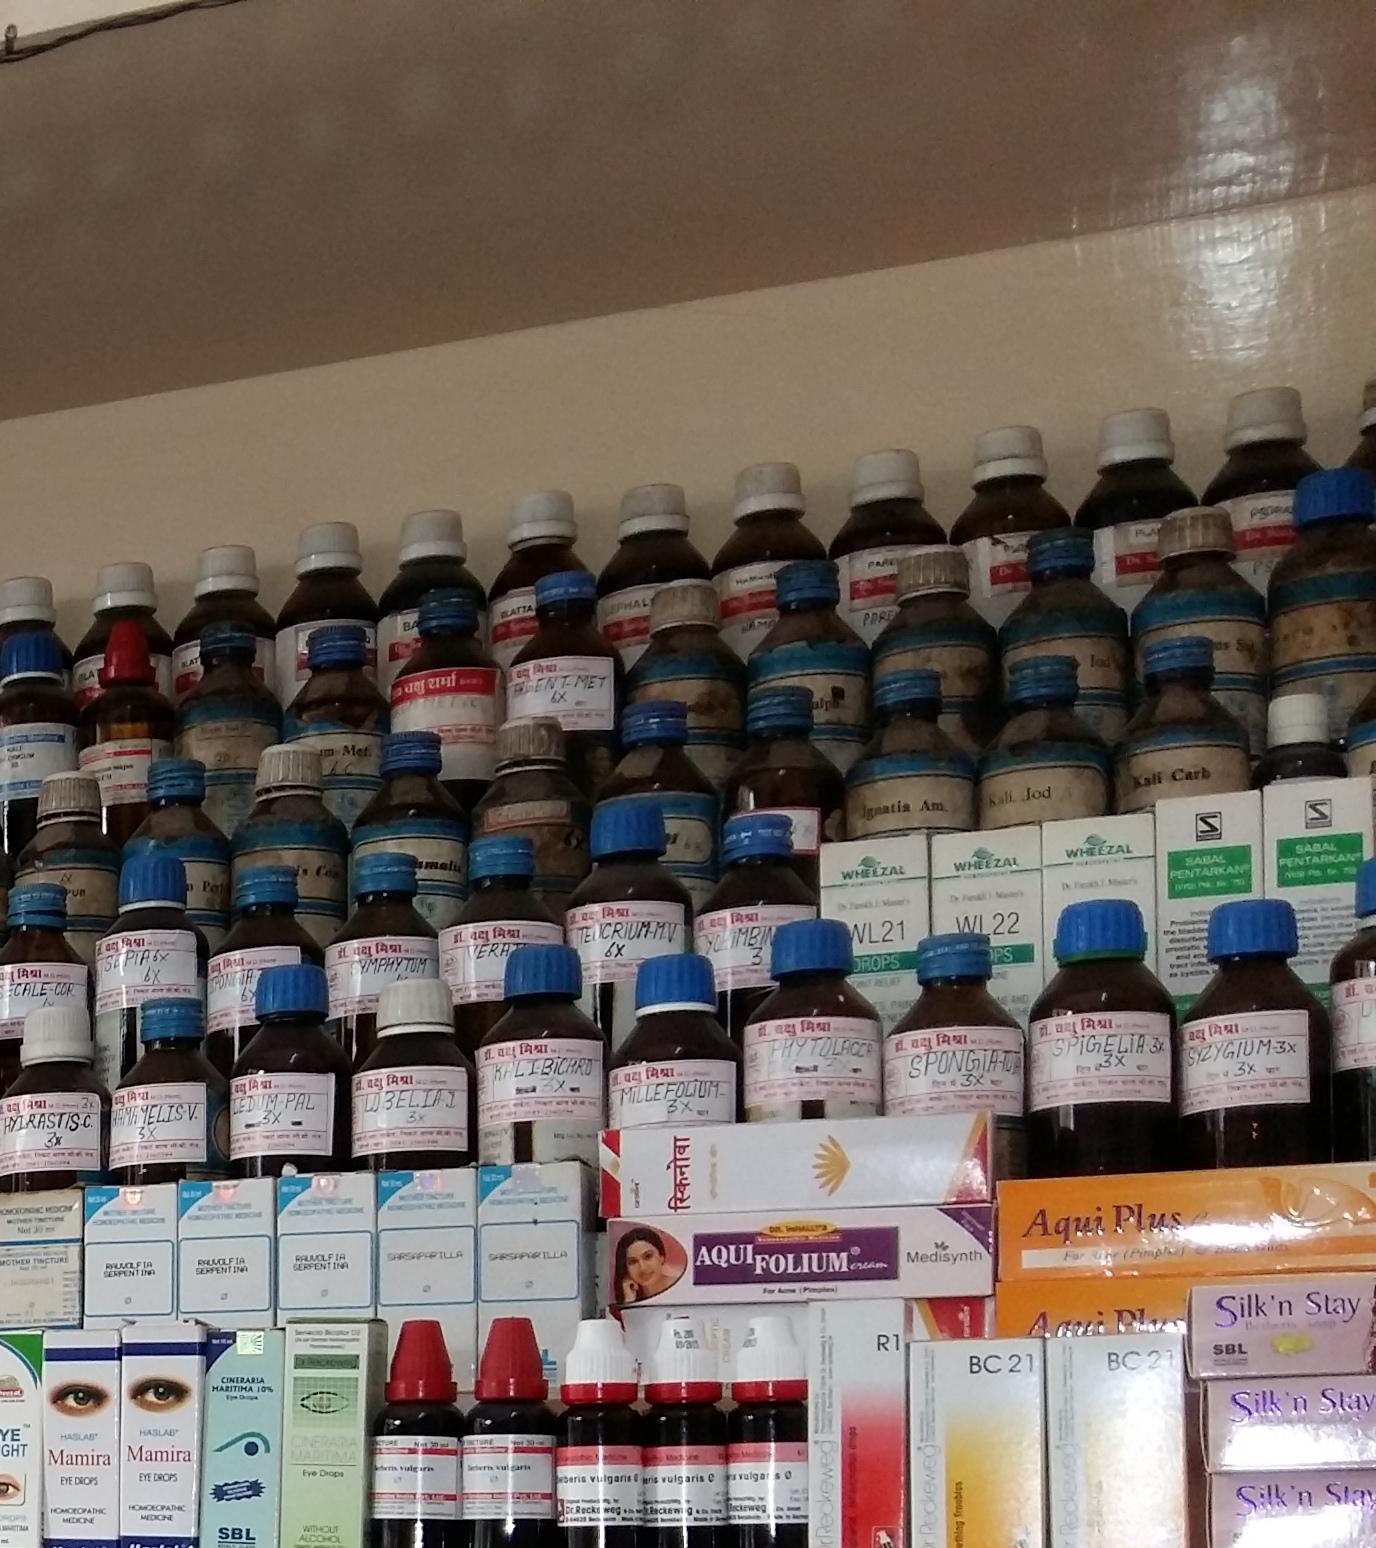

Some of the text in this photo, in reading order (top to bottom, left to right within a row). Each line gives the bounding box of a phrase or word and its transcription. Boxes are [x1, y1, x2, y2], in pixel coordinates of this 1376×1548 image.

[1023, 1202, 1182, 1238] Aqui Plus
[907, 1250, 982, 1264] Medisynth
[1214, 1293, 1361, 1330] Silk'n Stay
[876, 1333, 900, 1352] R1
[968, 1354, 1035, 1375] BC 21
[1107, 1352, 1145, 1370] BC
[212, 1385, 253, 1393] MARITIMA
[1231, 1387, 1375, 1422] Silk'n Stay
[49, 1447, 111, 1467] Mamira
[126, 1443, 192, 1464] Mamira
[139, 1472, 178, 1483] EYE DROPS
[303, 1469, 344, 1478] Eye Drops
[60, 1475, 98, 1486] EYE DROPS
[51, 1508, 107, 1517] HOMOEOPATHIC
[128, 1504, 186, 1513] HOMOEOPATHIC
[62, 1516, 94, 1524] MEDICINE
[140, 1513, 173, 1522] MEDICINE
[303, 1525, 339, 1533] WITHOUT
[299, 1534, 341, 1544] ALCOHOL
